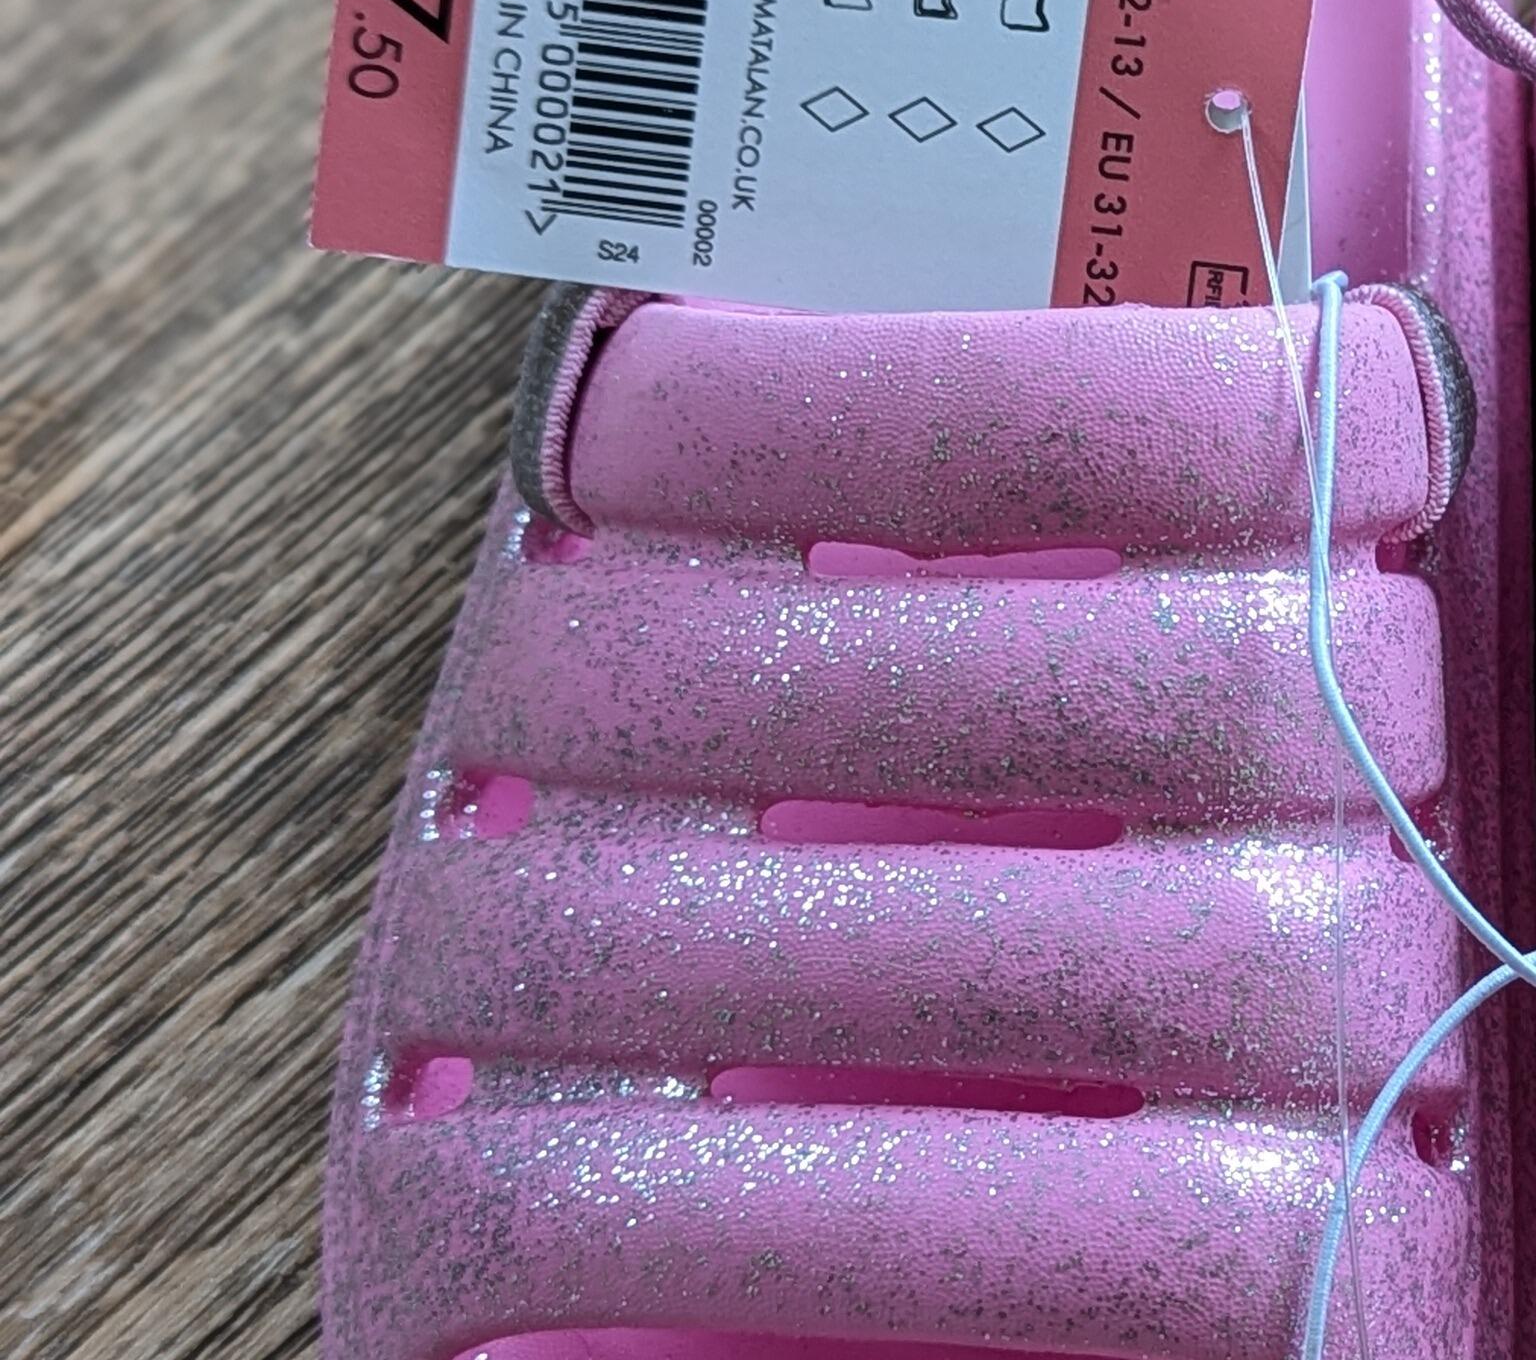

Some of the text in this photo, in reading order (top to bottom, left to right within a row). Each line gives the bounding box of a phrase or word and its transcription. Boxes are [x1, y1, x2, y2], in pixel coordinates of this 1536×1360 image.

[498, 1, 521, 38] IN
[485, 47, 522, 155] CHINA
[1099, 86, 1141, 121] /
[1098, 131, 1134, 181] EU
[598, 241, 640, 262] S24
[693, 199, 718, 266] 00002
[1082, 192, 1128, 307] 31-32
